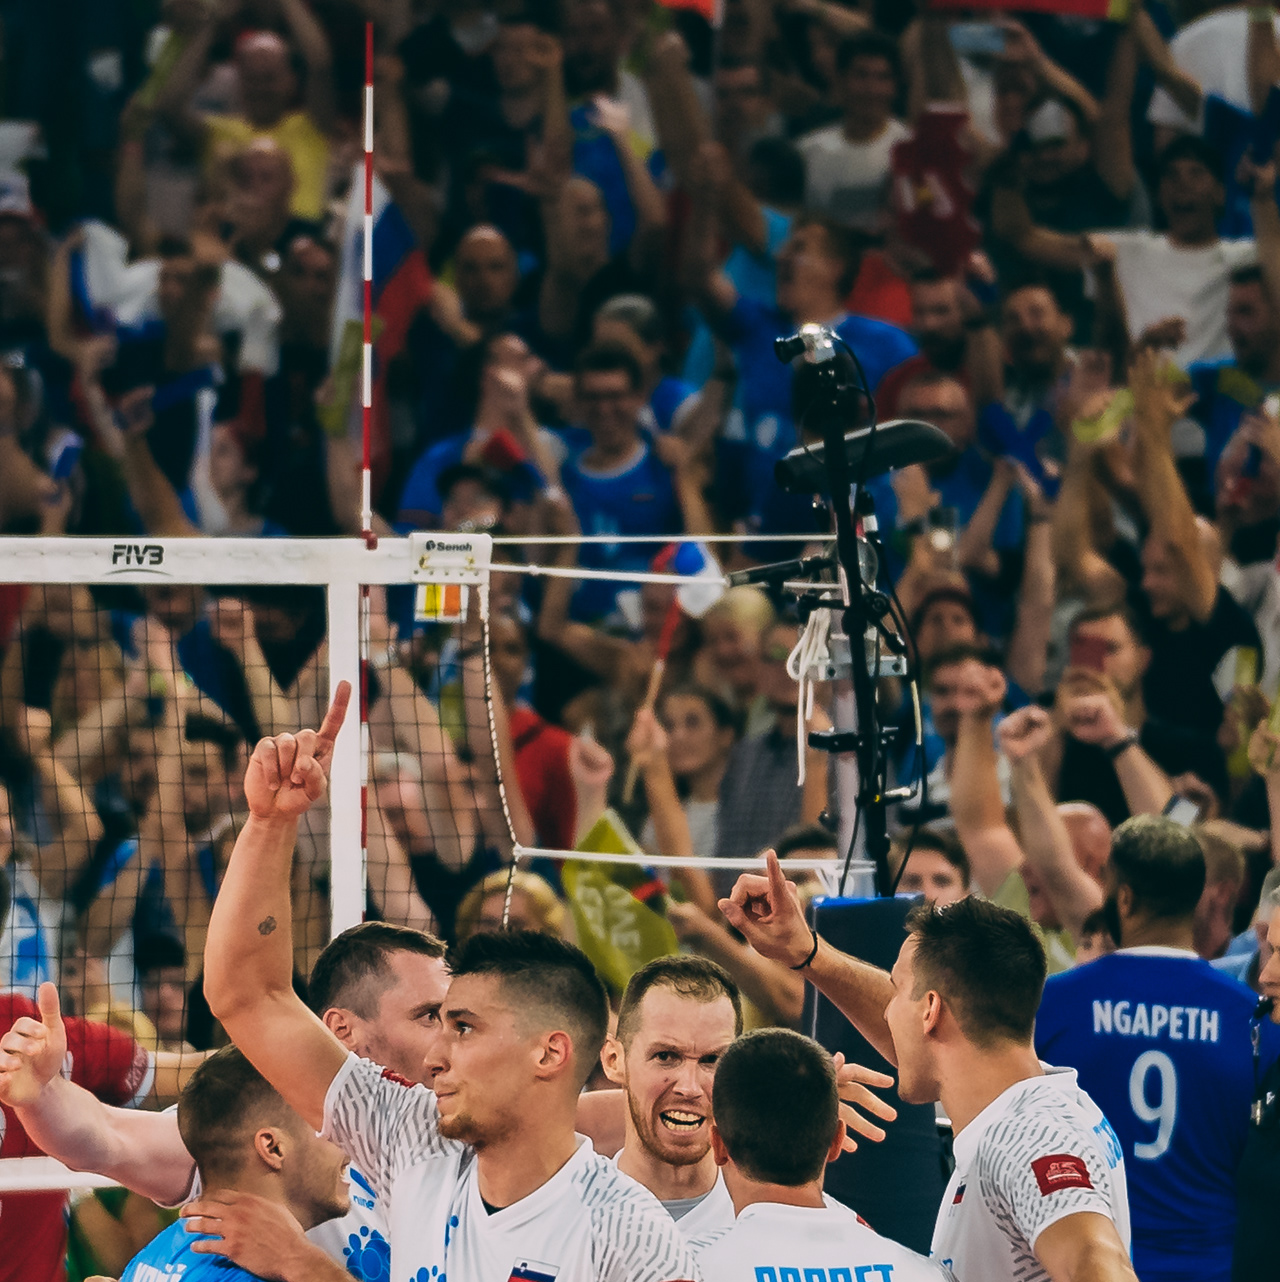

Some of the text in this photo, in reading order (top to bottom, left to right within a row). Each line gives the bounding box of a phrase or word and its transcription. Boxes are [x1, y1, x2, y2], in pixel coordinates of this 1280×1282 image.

[437, 541, 473, 553] Senoh
[1092, 1000, 1219, 1043] NGAPETH
[1129, 1049, 1177, 1160] 9
